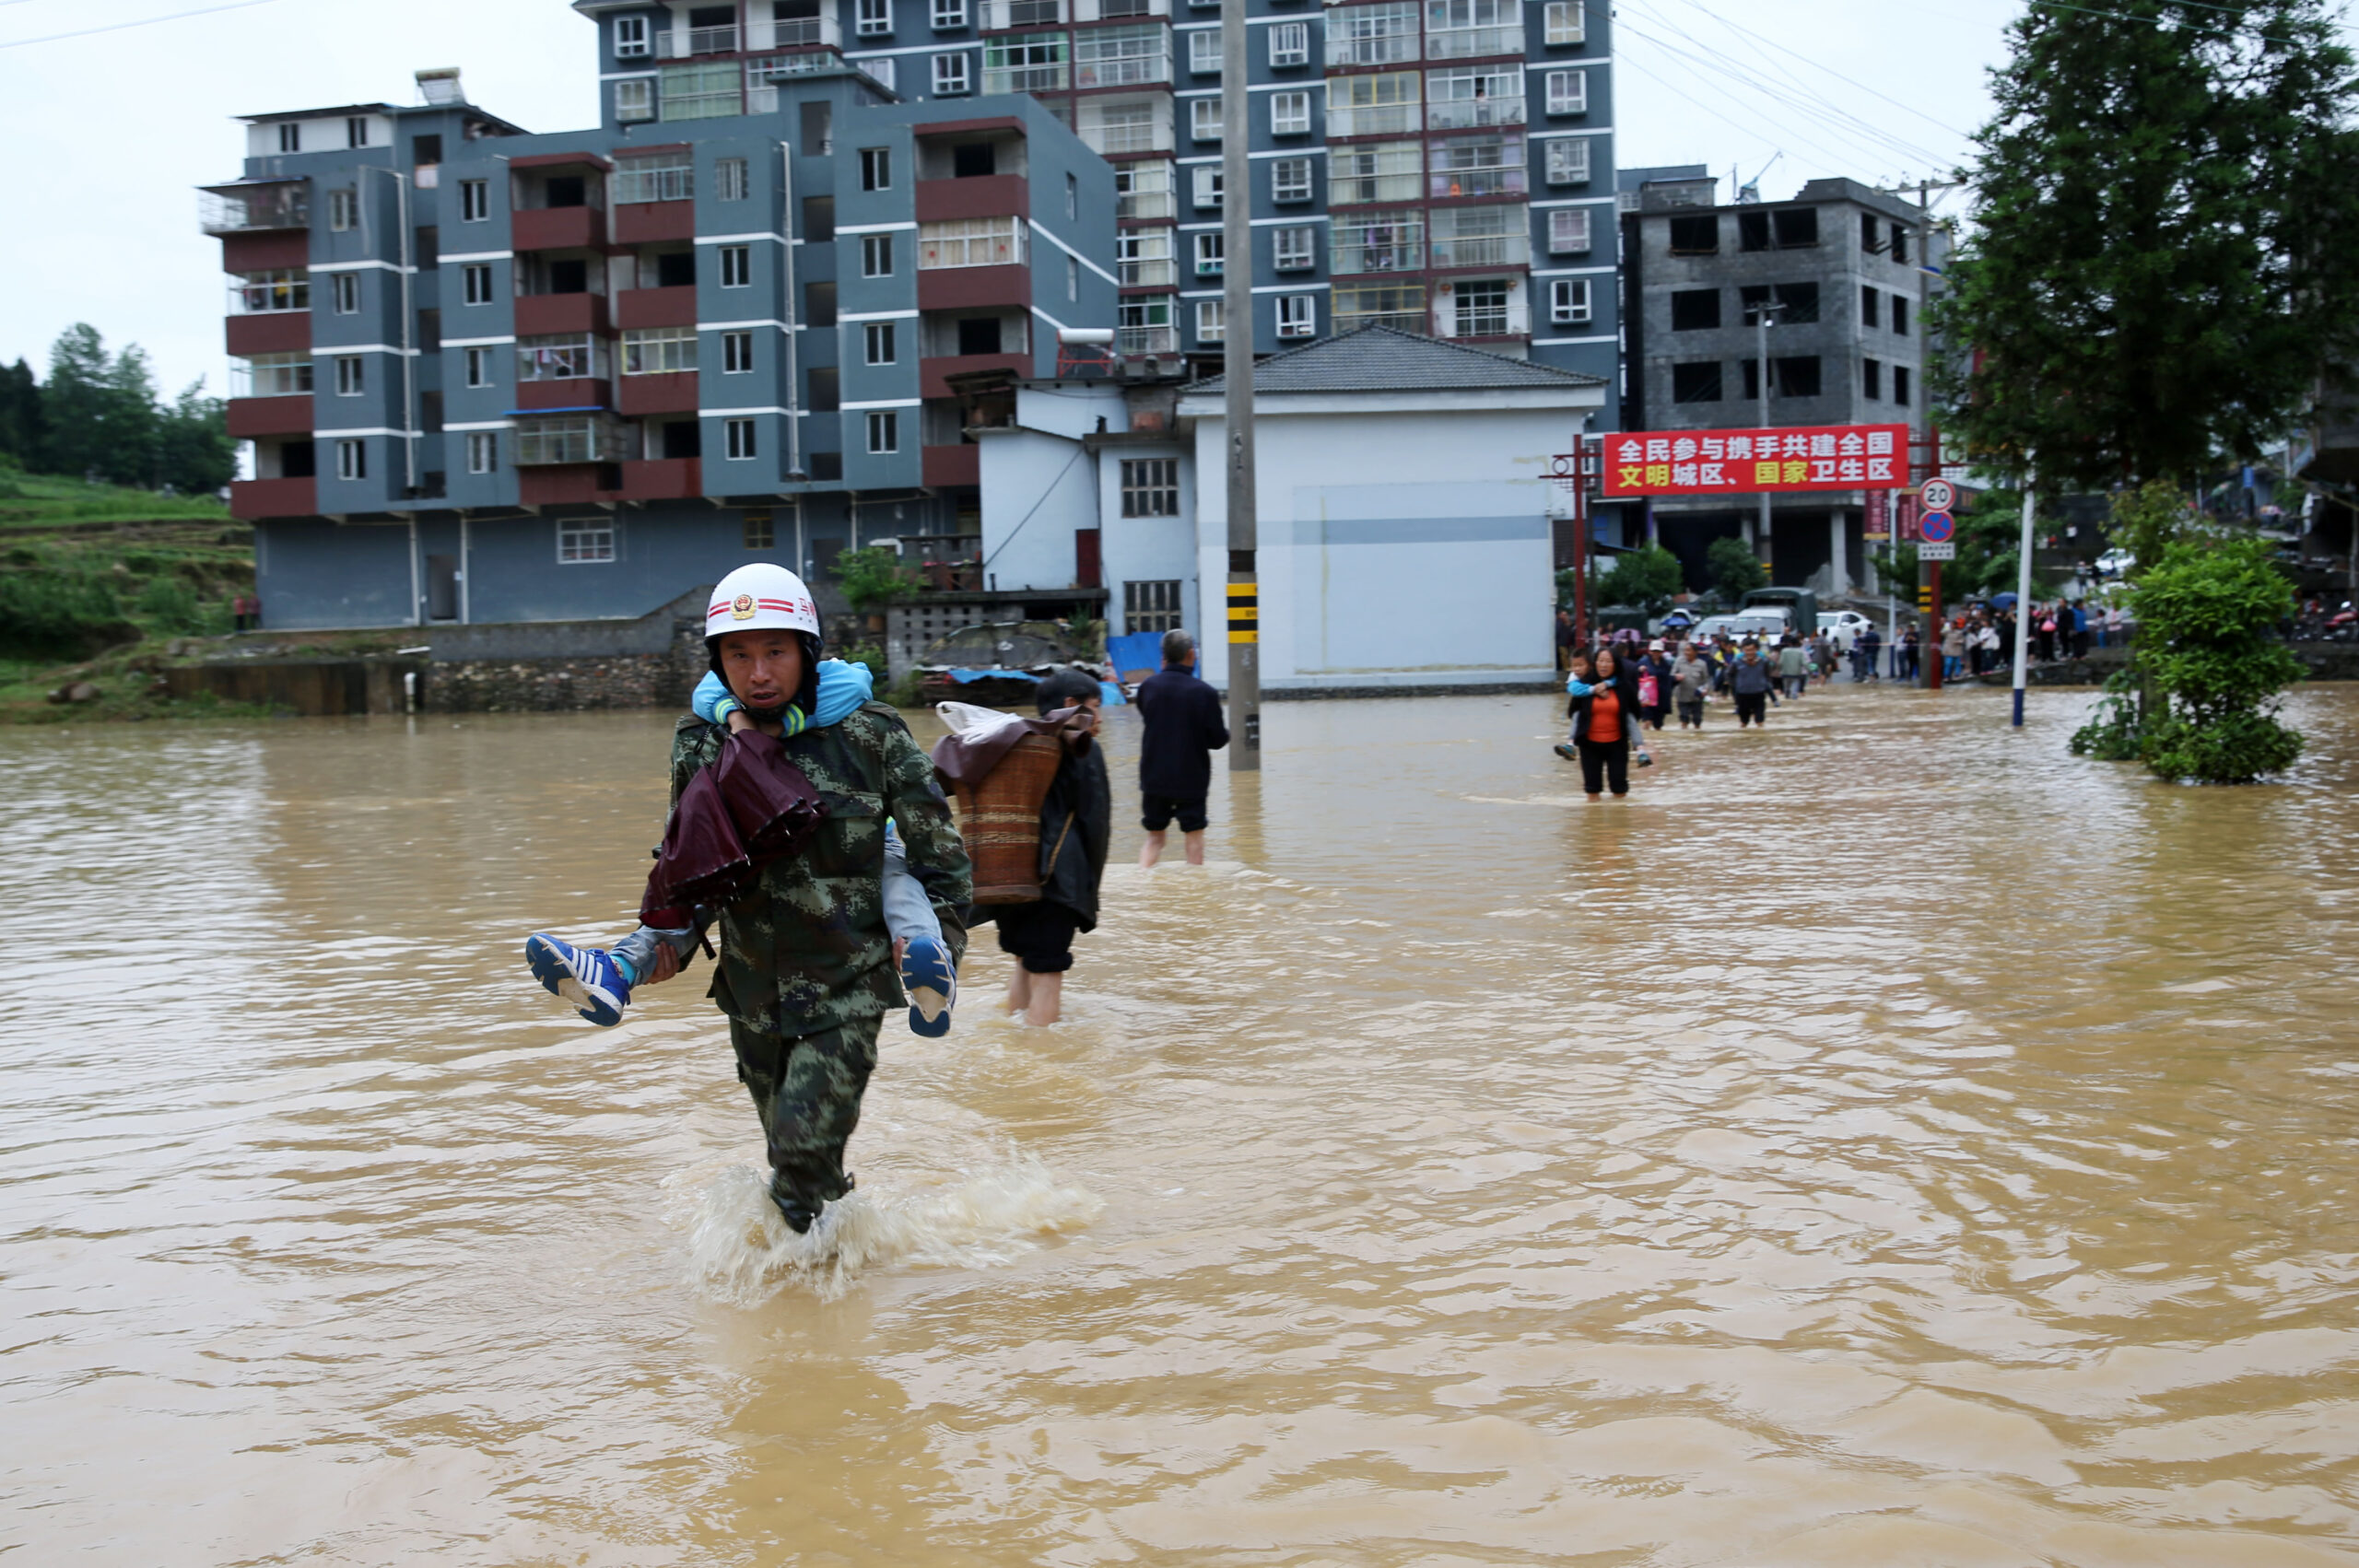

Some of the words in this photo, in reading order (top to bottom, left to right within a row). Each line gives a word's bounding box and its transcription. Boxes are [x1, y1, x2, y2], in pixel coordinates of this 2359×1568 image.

[1618, 431, 1894, 462] 全民参与携手共建全国
[1618, 458, 1894, 488] 文明城区、国家卫生区
[1927, 487, 1948, 503] 20
